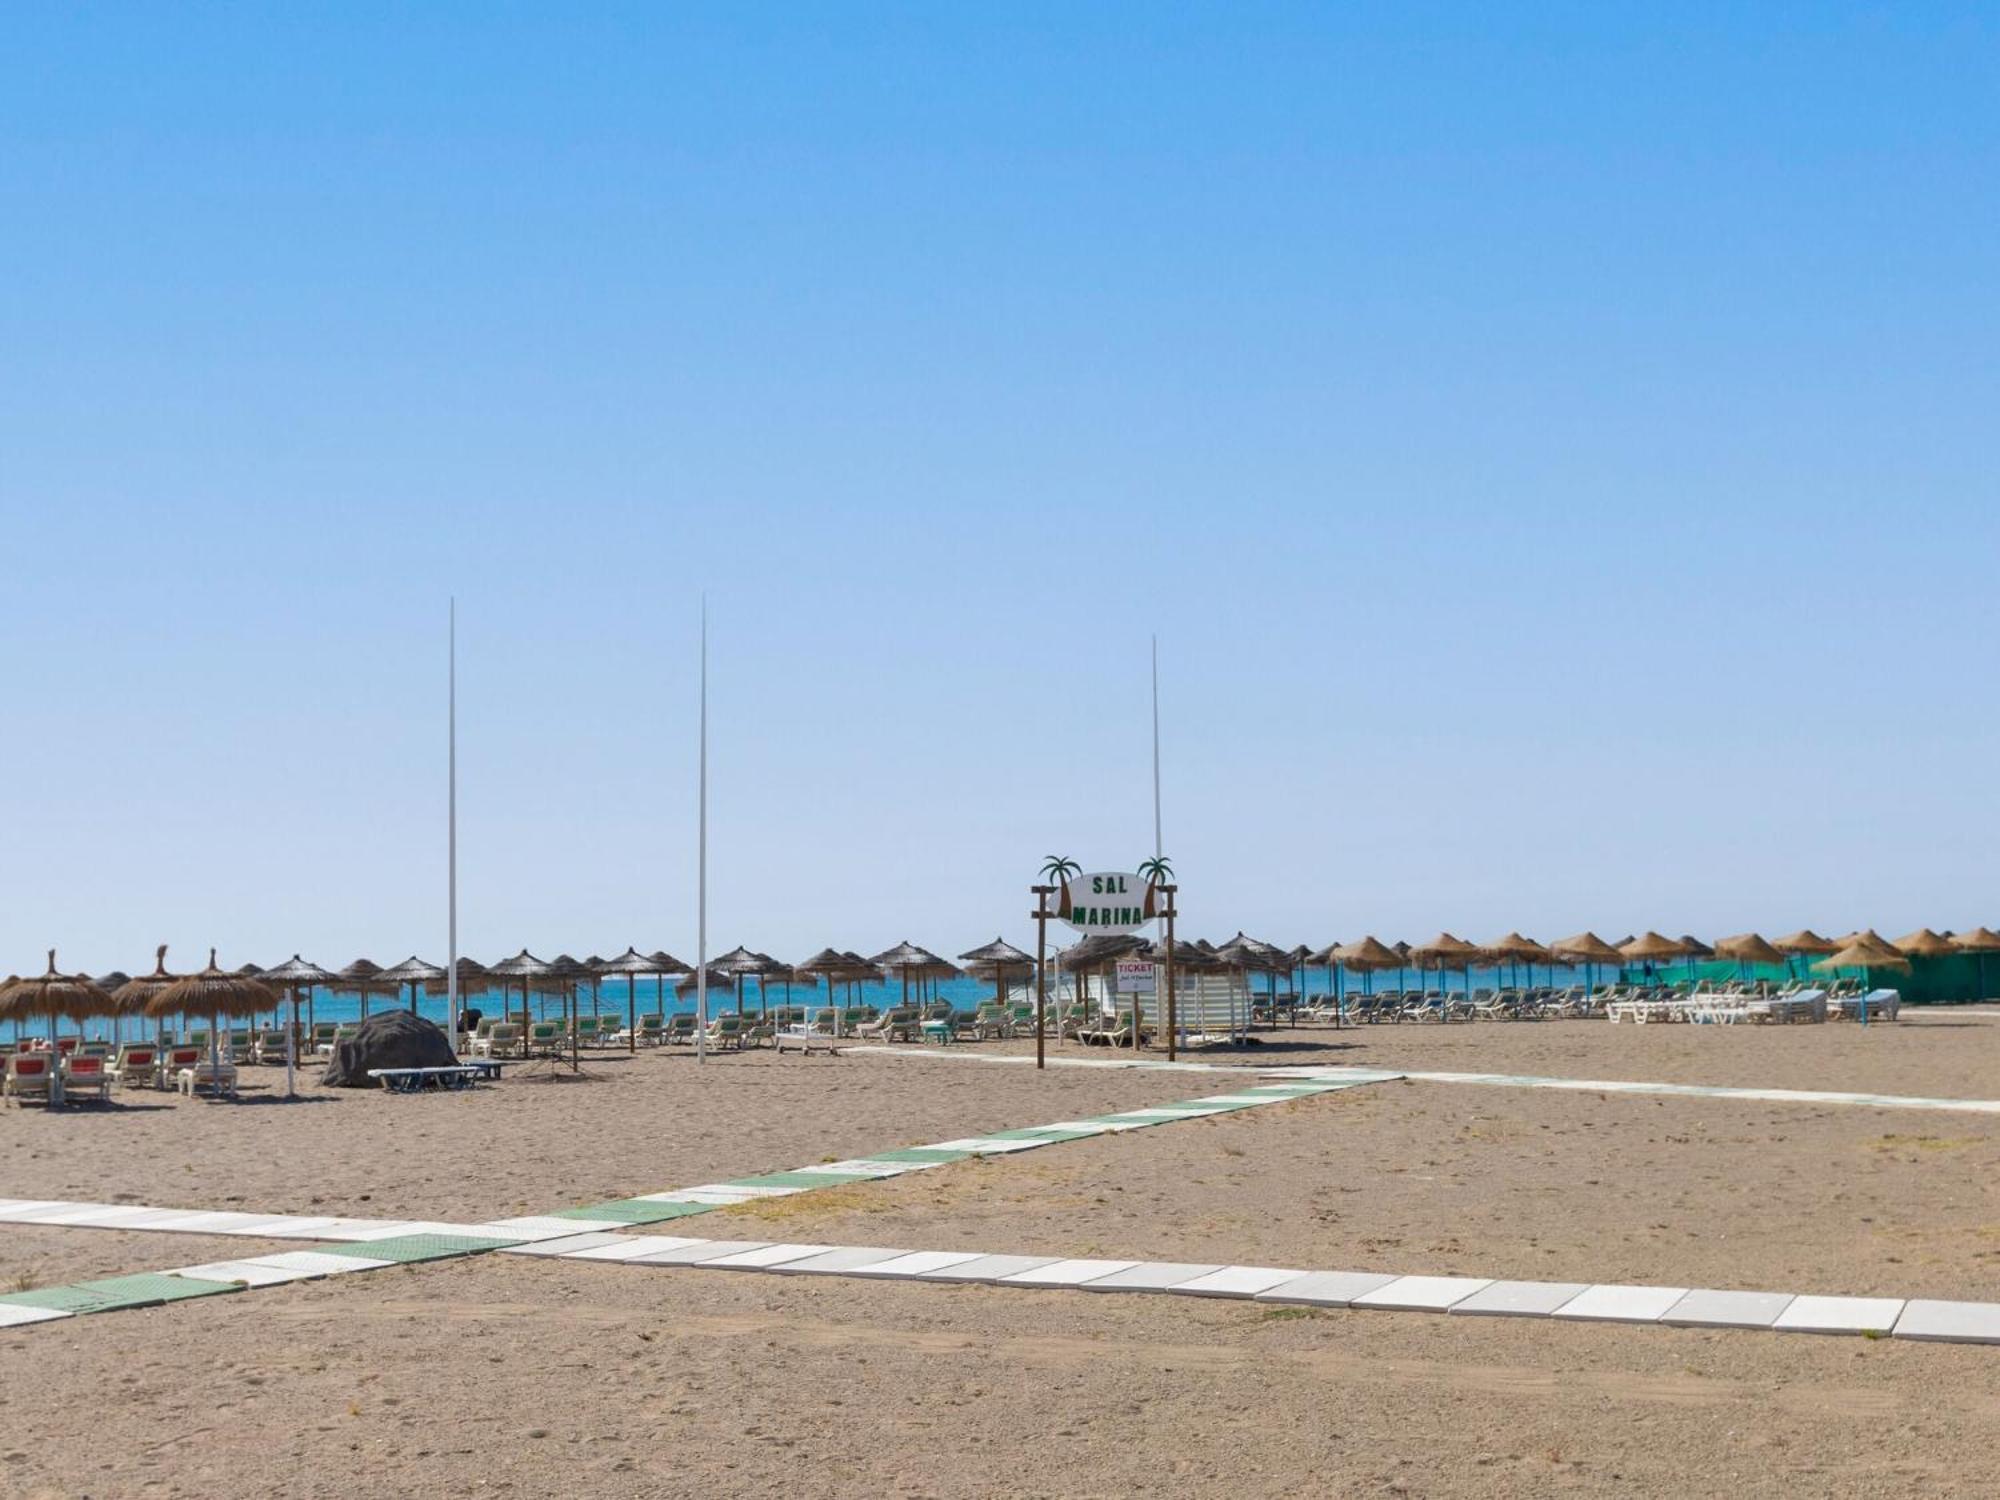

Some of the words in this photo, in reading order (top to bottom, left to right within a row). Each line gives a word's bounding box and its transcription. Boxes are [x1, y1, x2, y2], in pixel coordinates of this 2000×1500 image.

[1093, 876, 1128, 894] SAL
[1072, 907, 1142, 925] MARINA
[1118, 963, 1153, 973] TICKET
